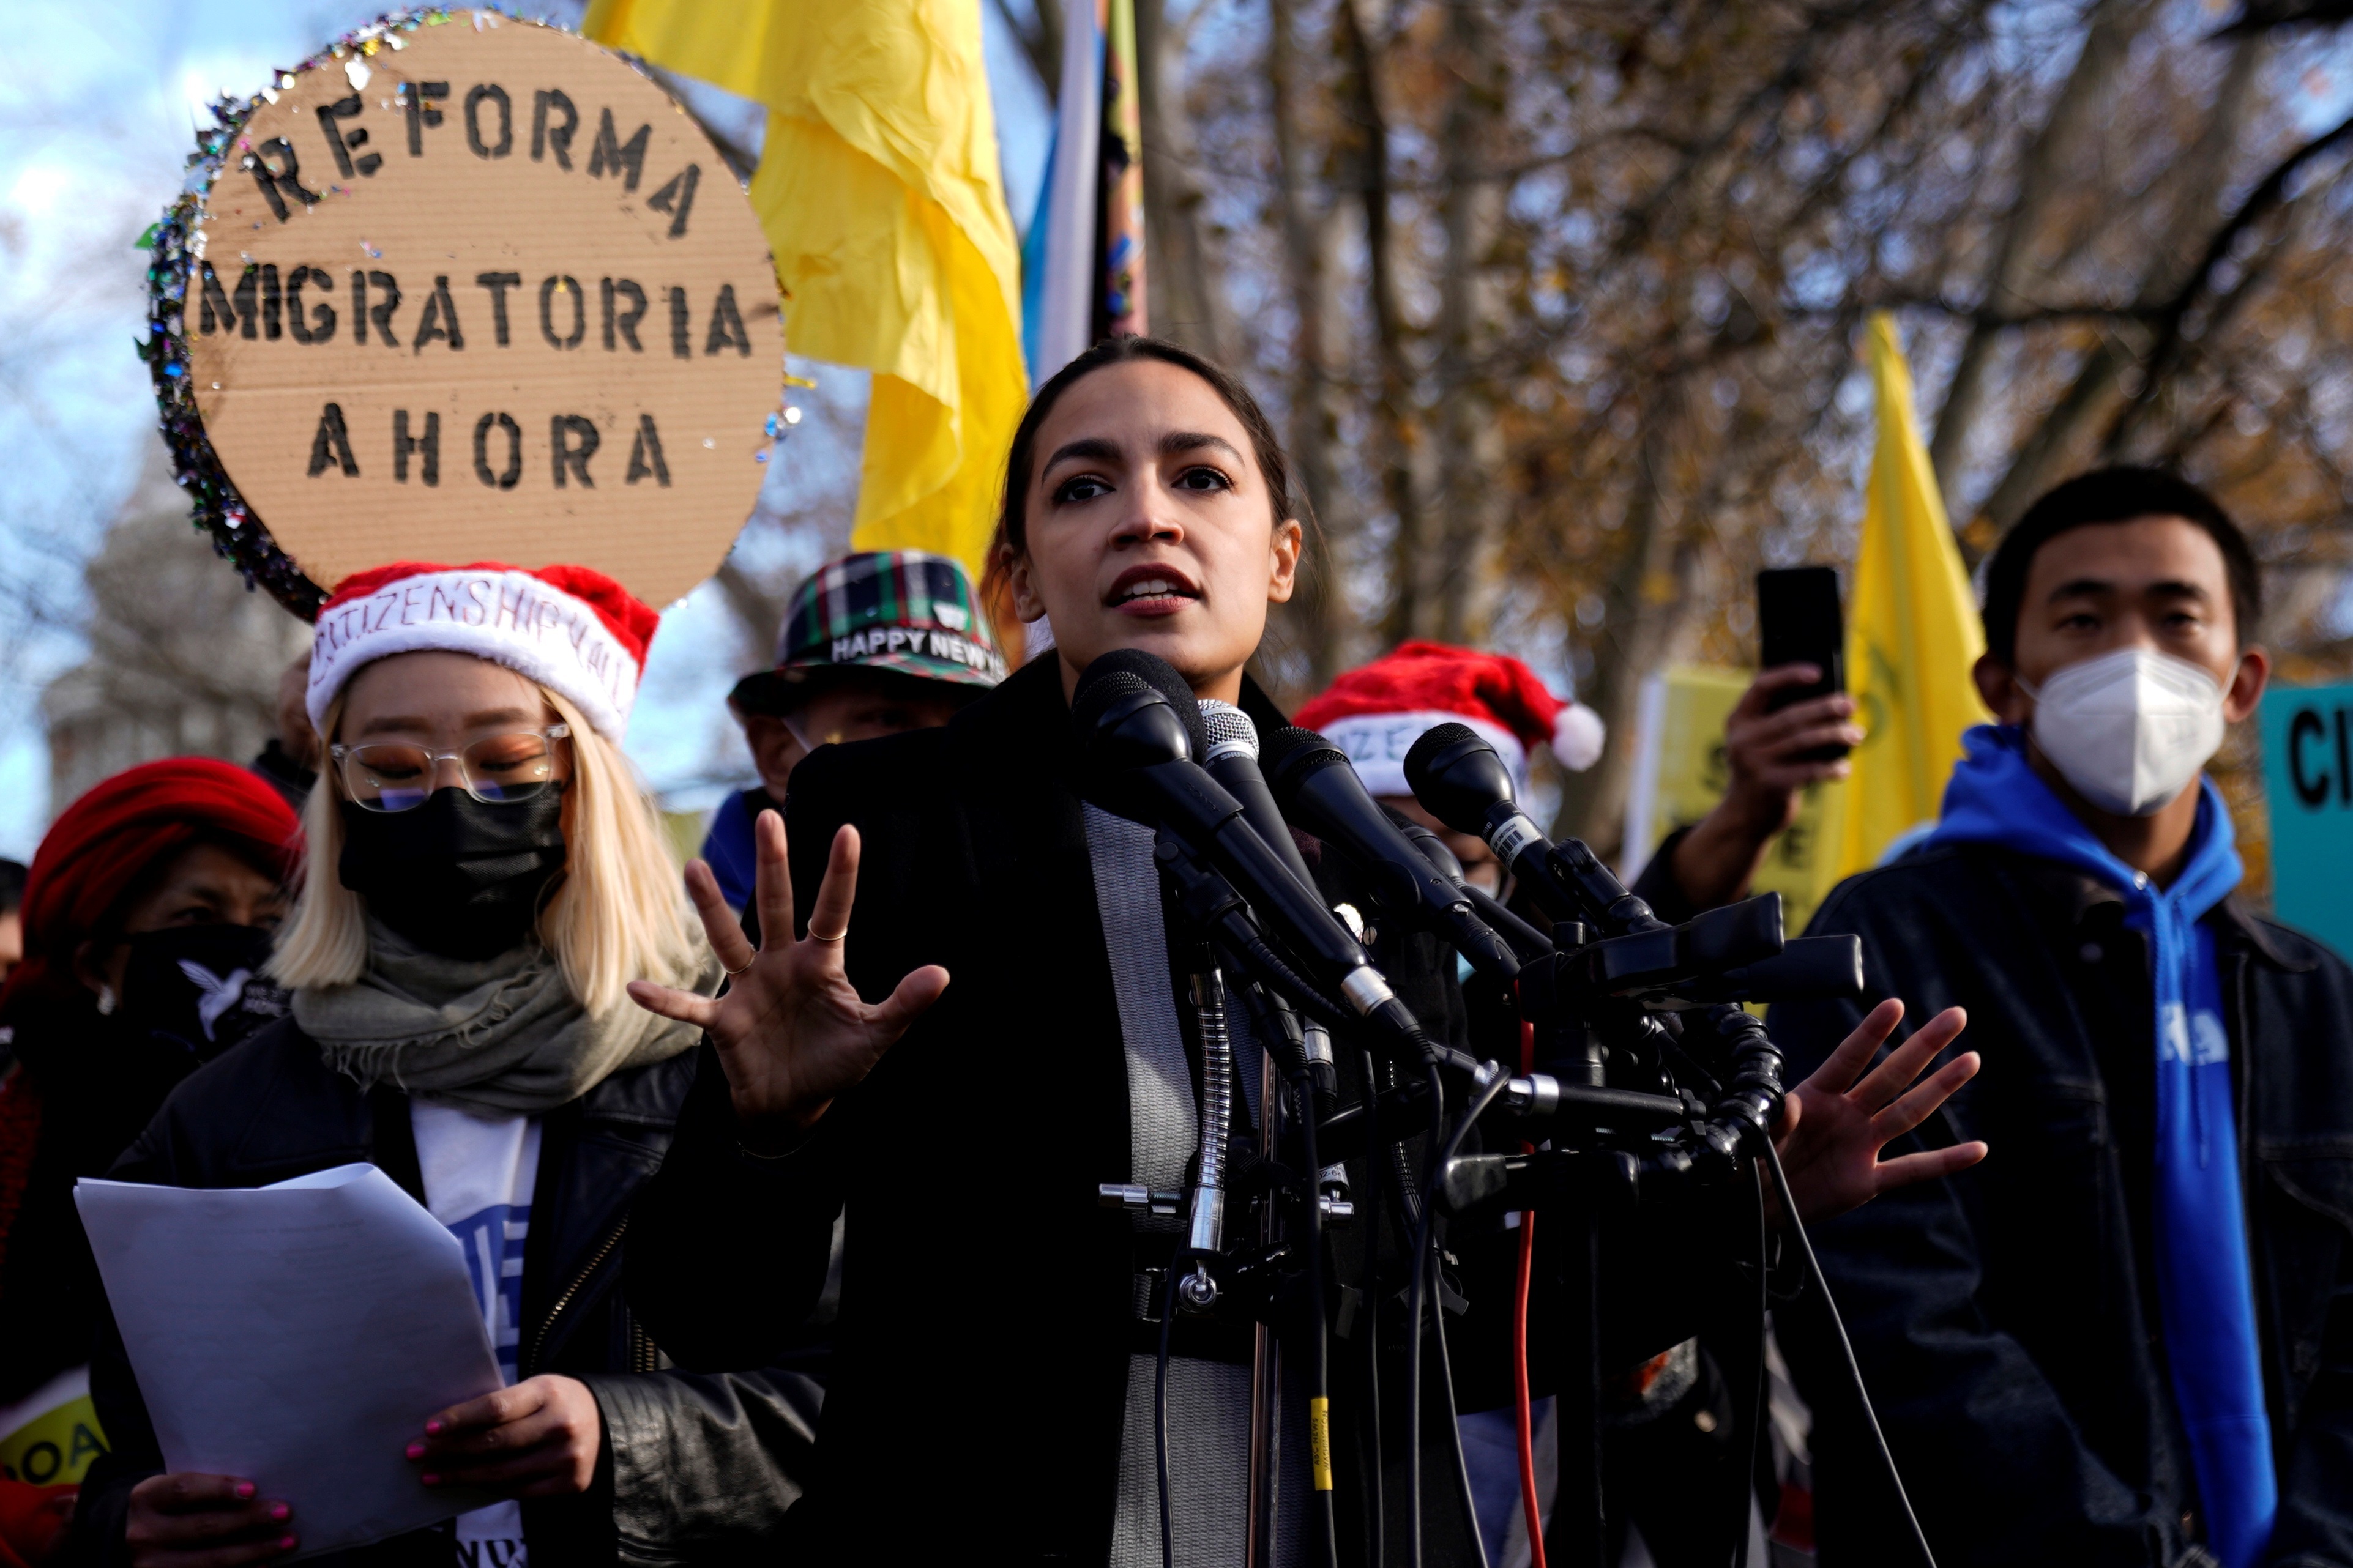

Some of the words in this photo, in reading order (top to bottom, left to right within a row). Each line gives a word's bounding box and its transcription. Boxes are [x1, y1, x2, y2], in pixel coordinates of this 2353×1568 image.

[247, 80, 701, 239] REFORMA
[198, 259, 752, 359] MIGRATORIA
[307, 402, 672, 491] AHORA
[832, 626, 925, 663] HAPPY
[930, 630, 988, 671] NEW
[2288, 708, 2353, 812] CI
[1321, 1410, 1330, 1471] WASHINGTON
